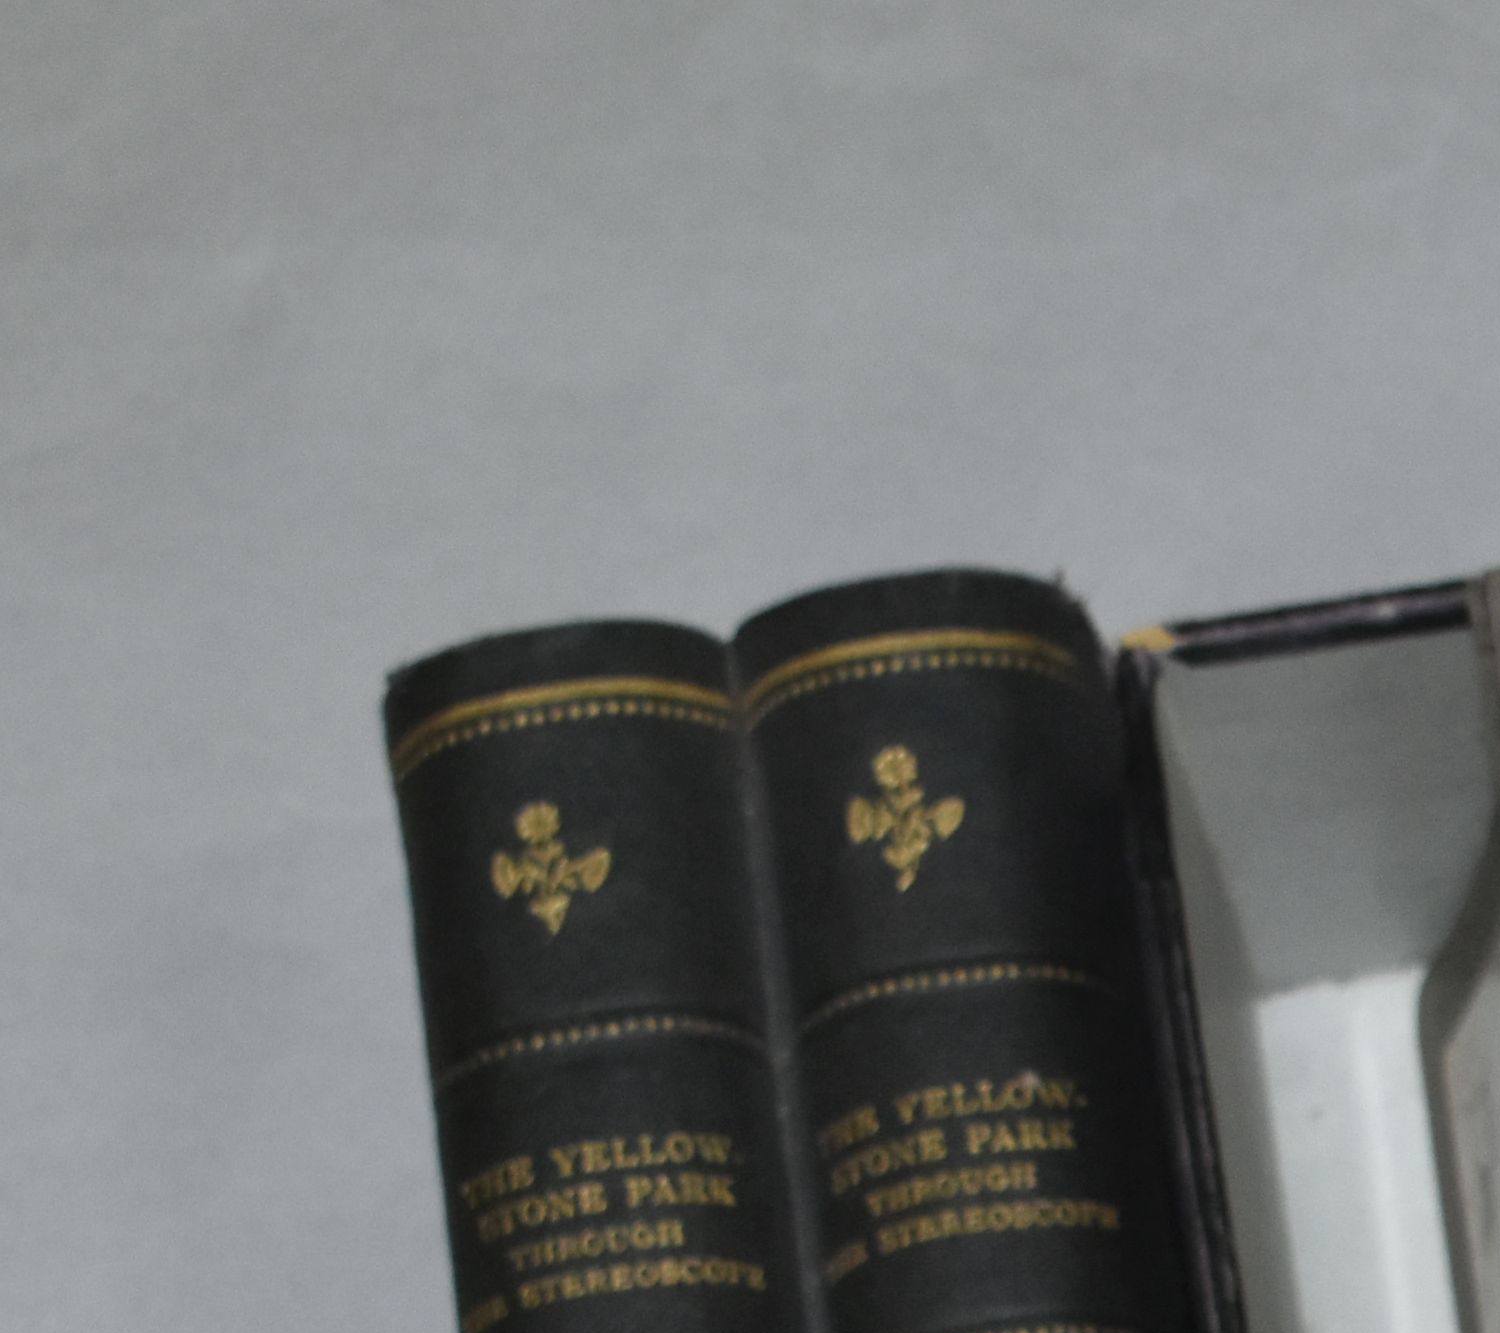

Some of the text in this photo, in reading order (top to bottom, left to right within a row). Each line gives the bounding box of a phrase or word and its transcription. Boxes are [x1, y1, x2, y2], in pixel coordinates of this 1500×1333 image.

[461, 1155, 534, 1209] THE
[831, 1118, 1077, 1194] STONE PARK
[478, 1171, 736, 1242] STONE PARK
[866, 1161, 1037, 1216] THROUGH
[510, 1218, 685, 1271] THROUGH
[877, 1200, 1120, 1255] STEREOSCOPE
[518, 1256, 767, 1309] STEREOSCOPE
